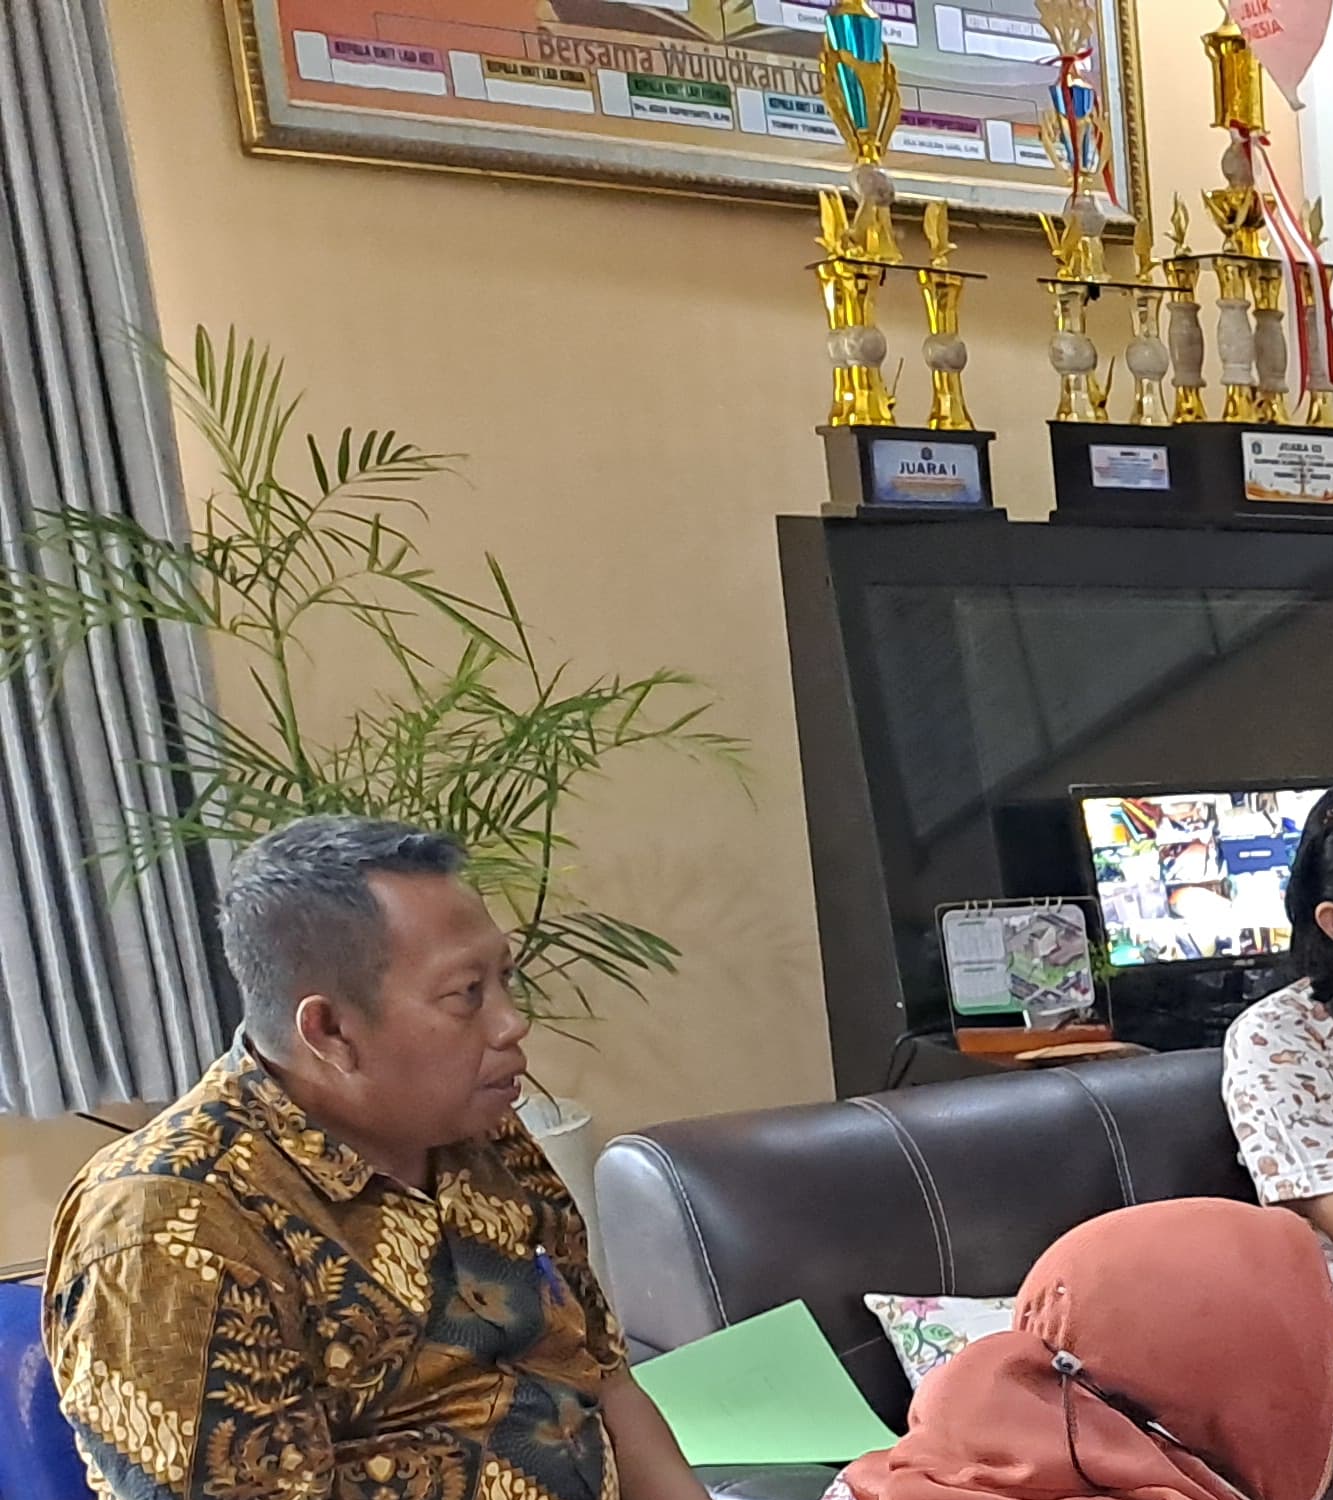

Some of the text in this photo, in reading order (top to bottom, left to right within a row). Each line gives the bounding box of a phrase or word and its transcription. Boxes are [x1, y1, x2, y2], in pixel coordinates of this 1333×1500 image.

[538, 26, 653, 72] Bersama
[659, 42, 786, 90] Wujudkan
[899, 462, 957, 476] JUARA I
